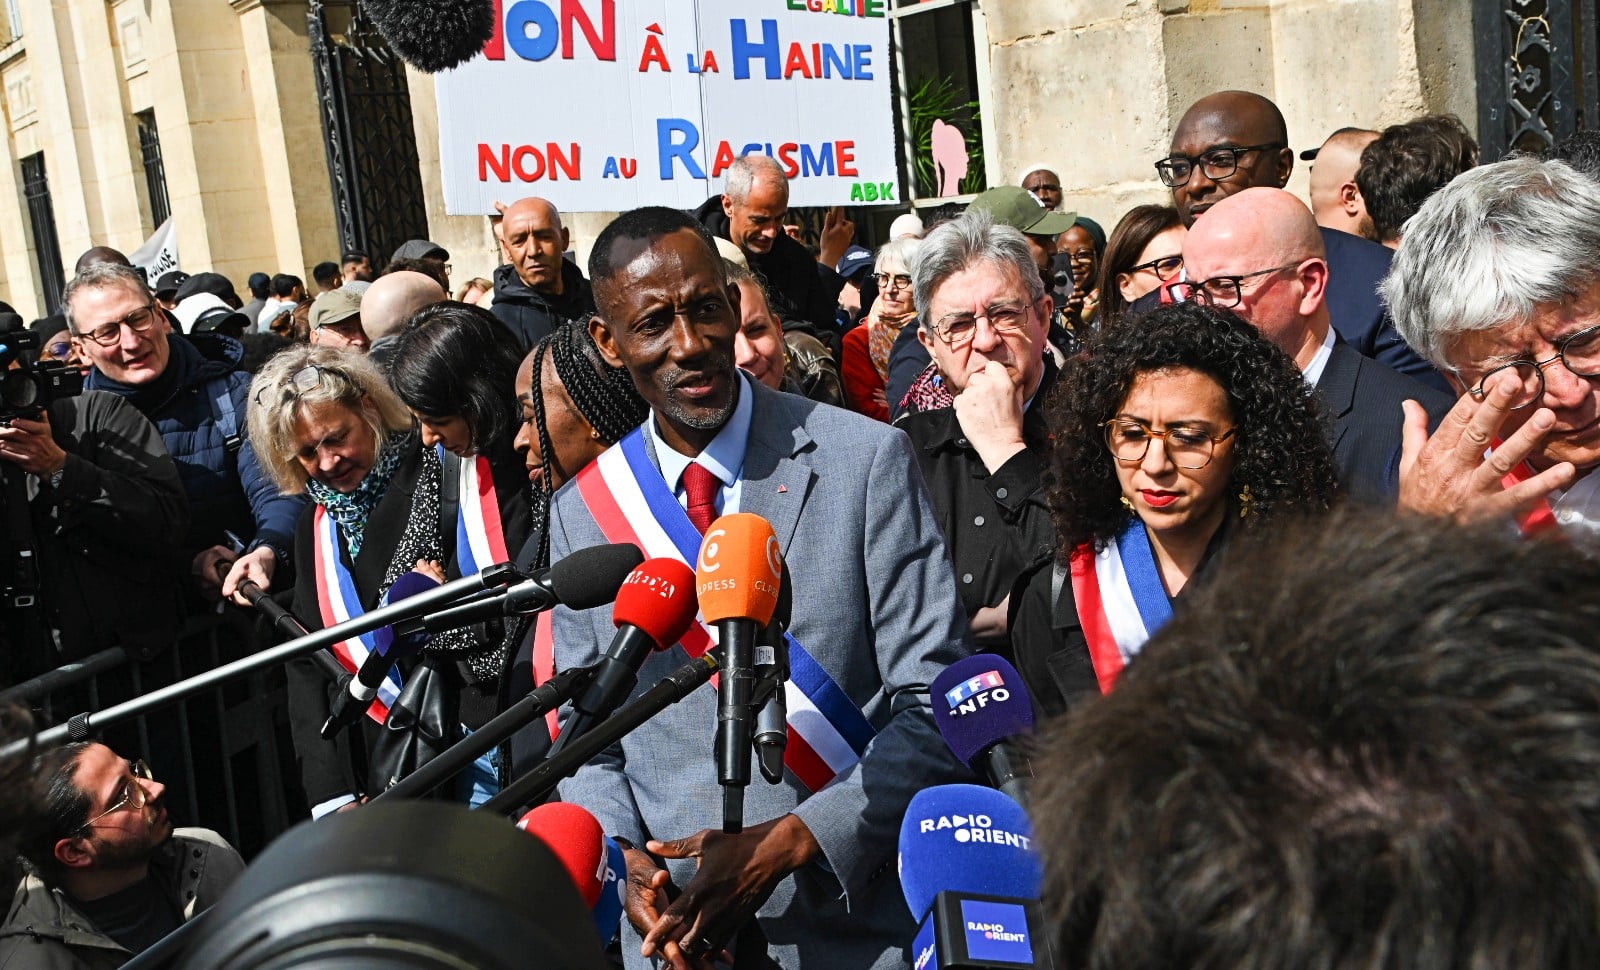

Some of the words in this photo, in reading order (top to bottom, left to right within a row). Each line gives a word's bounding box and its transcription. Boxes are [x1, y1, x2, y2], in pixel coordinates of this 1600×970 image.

[687, 50, 719, 74] LA
[730, 18, 874, 80] HAINE
[477, 142, 580, 183] NON
[602, 156, 637, 179] AU
[850, 182, 895, 202] ABK
[949, 673, 998, 702] TF1
[920, 814, 992, 834] RADIO
[954, 828, 1031, 850] ORIENT
[967, 921, 1004, 933] RADIO
[985, 931, 1025, 943] ORIENT
